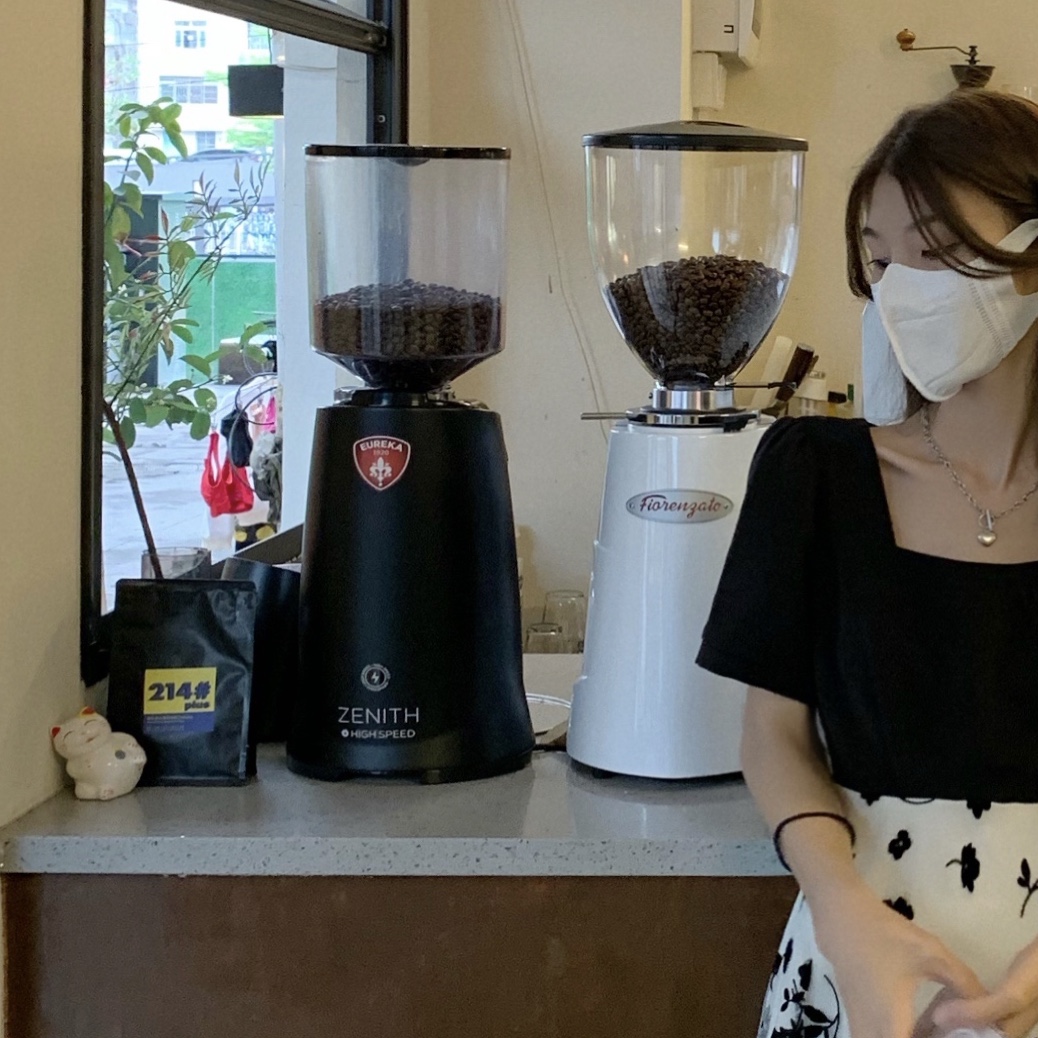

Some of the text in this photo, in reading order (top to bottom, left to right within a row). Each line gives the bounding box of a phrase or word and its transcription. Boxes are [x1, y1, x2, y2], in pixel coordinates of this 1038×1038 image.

[360, 440, 403, 453] EUREKA
[640, 494, 722, 519] Fiorenzato
[148, 681, 211, 701] 214#
[338, 706, 420, 724] ZENITH
[350, 729, 416, 739] HIGH SPEED
